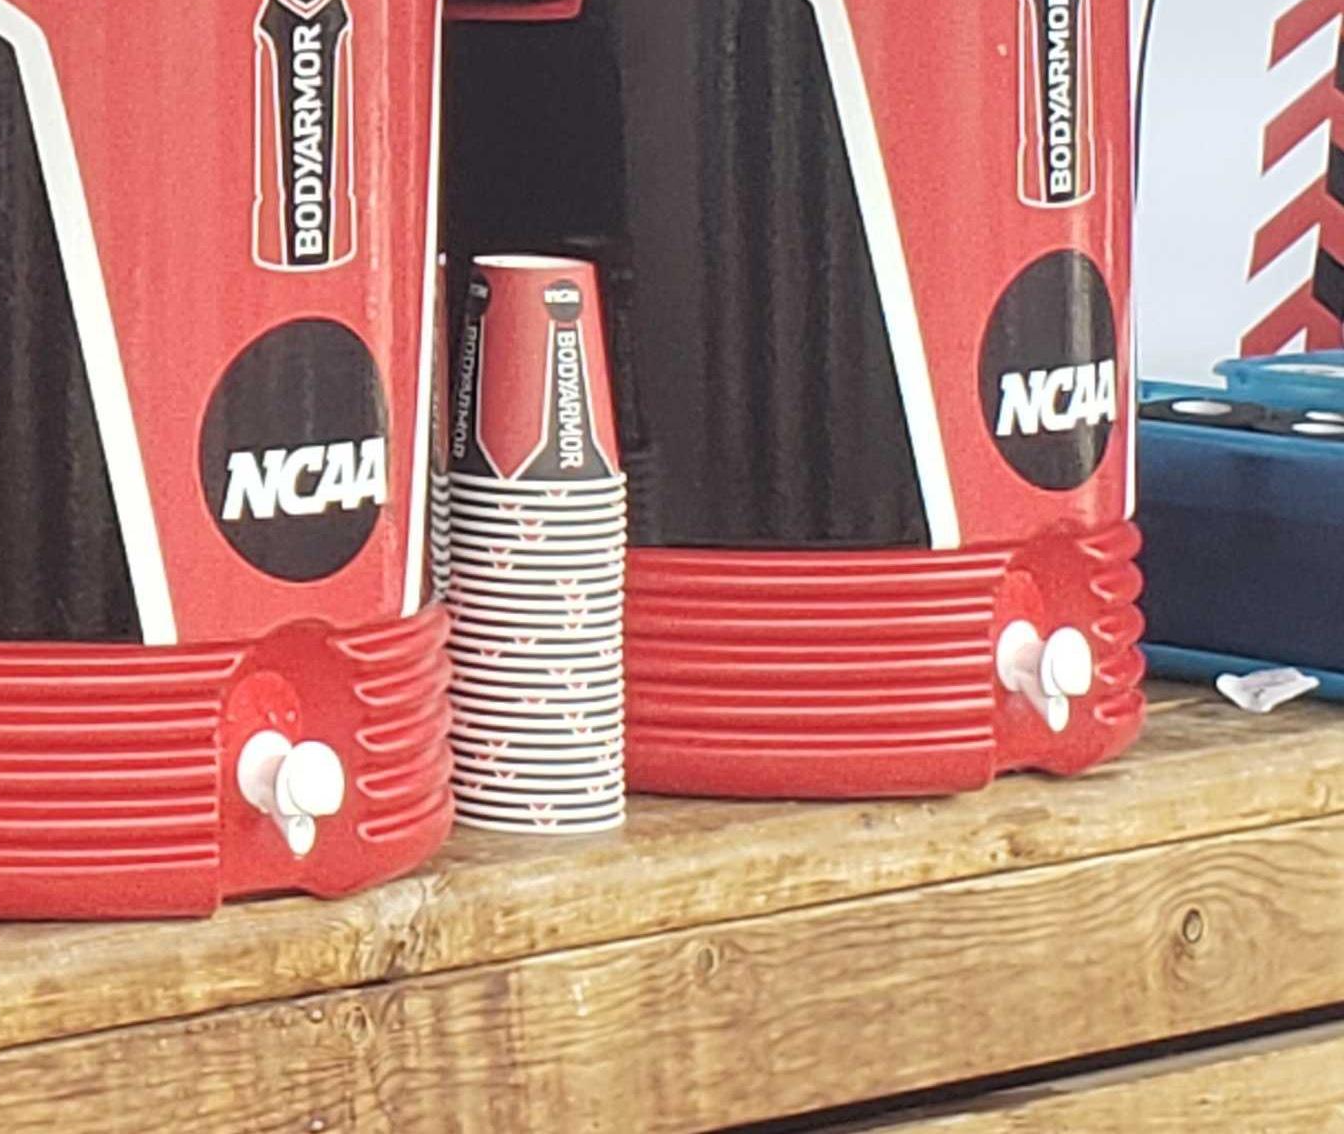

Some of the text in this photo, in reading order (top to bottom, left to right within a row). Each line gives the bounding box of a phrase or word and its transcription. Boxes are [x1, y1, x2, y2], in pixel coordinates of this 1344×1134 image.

[295, 23, 322, 256] BODYARMOR
[557, 330, 584, 469] BODYARMOR
[996, 360, 1116, 435] NCAA
[223, 437, 386, 521] NCAA
